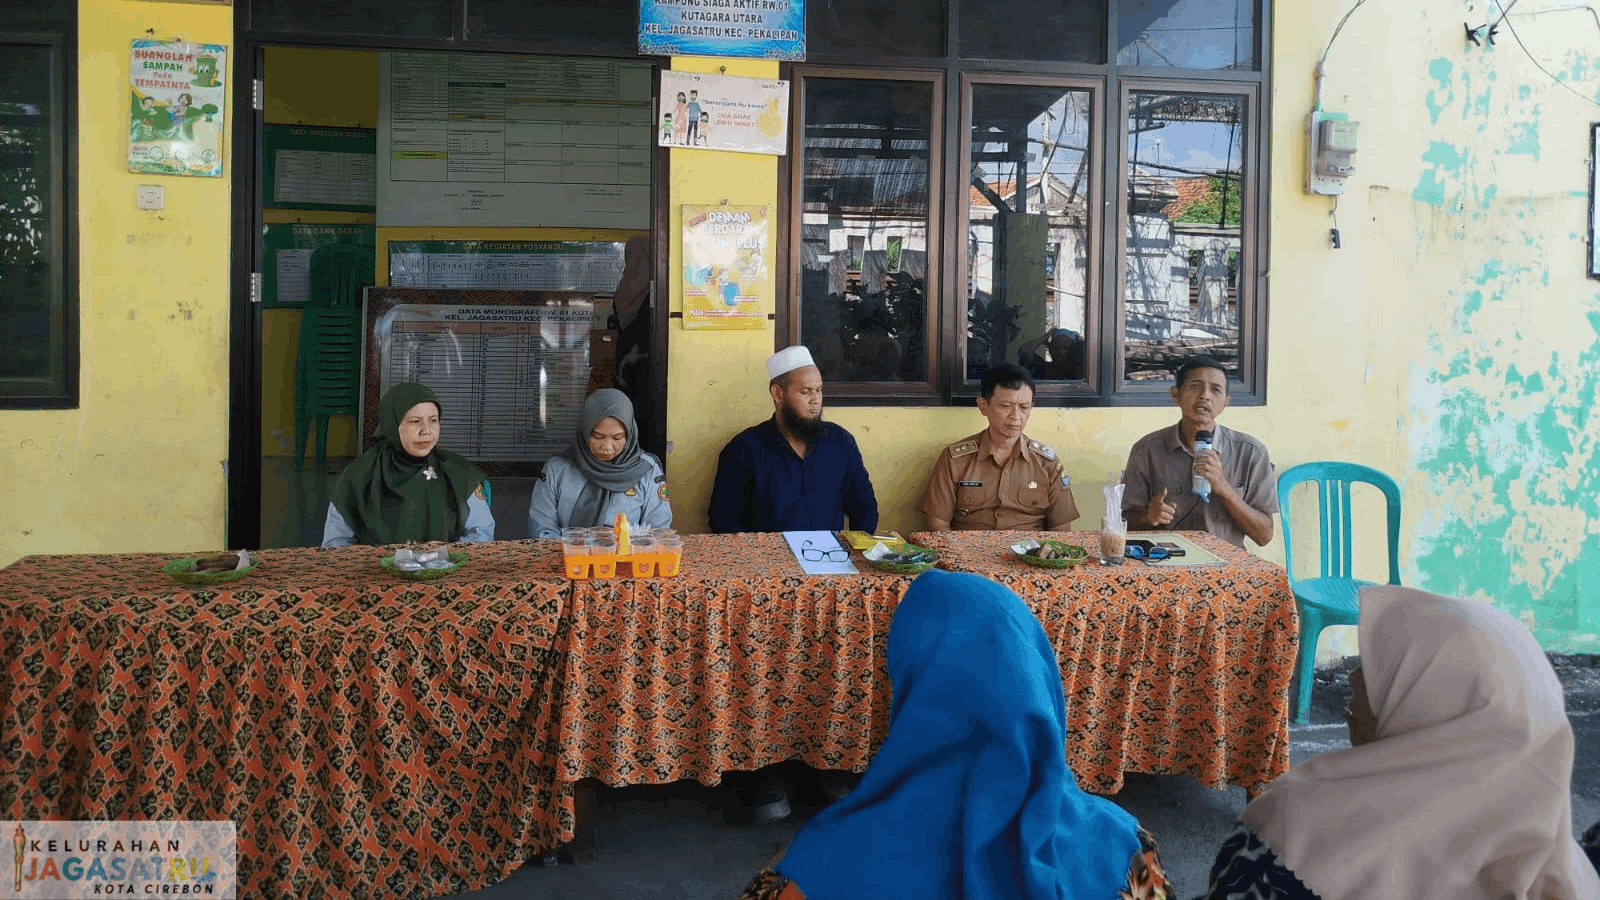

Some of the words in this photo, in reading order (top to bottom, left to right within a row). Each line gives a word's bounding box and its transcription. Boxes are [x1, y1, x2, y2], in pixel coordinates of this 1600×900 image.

[733, 0, 760, 9] AKTIF
[762, 1, 788, 11] RW.01
[681, 11, 730, 22] KUTAGARA
[733, 14, 763, 23] UTARA
[645, 24, 665, 34] KEL.
[668, 26, 722, 37] JAGASATRU
[724, 28, 745, 38] KEC.
[748, 29, 798, 40] PEKALIPAN
[134, 50, 193, 62] BUANGLAH
[143, 61, 183, 71] SAMPAH
[135, 79, 191, 90] TEMPATNYA
[708, 211, 751, 224] DEMAM
[484, 243, 521, 251] KEGIATAN
[524, 243, 562, 251] POSYANDU
[484, 308, 538, 316] MONOGRAFI
[467, 314, 522, 322] JAGASATRU
